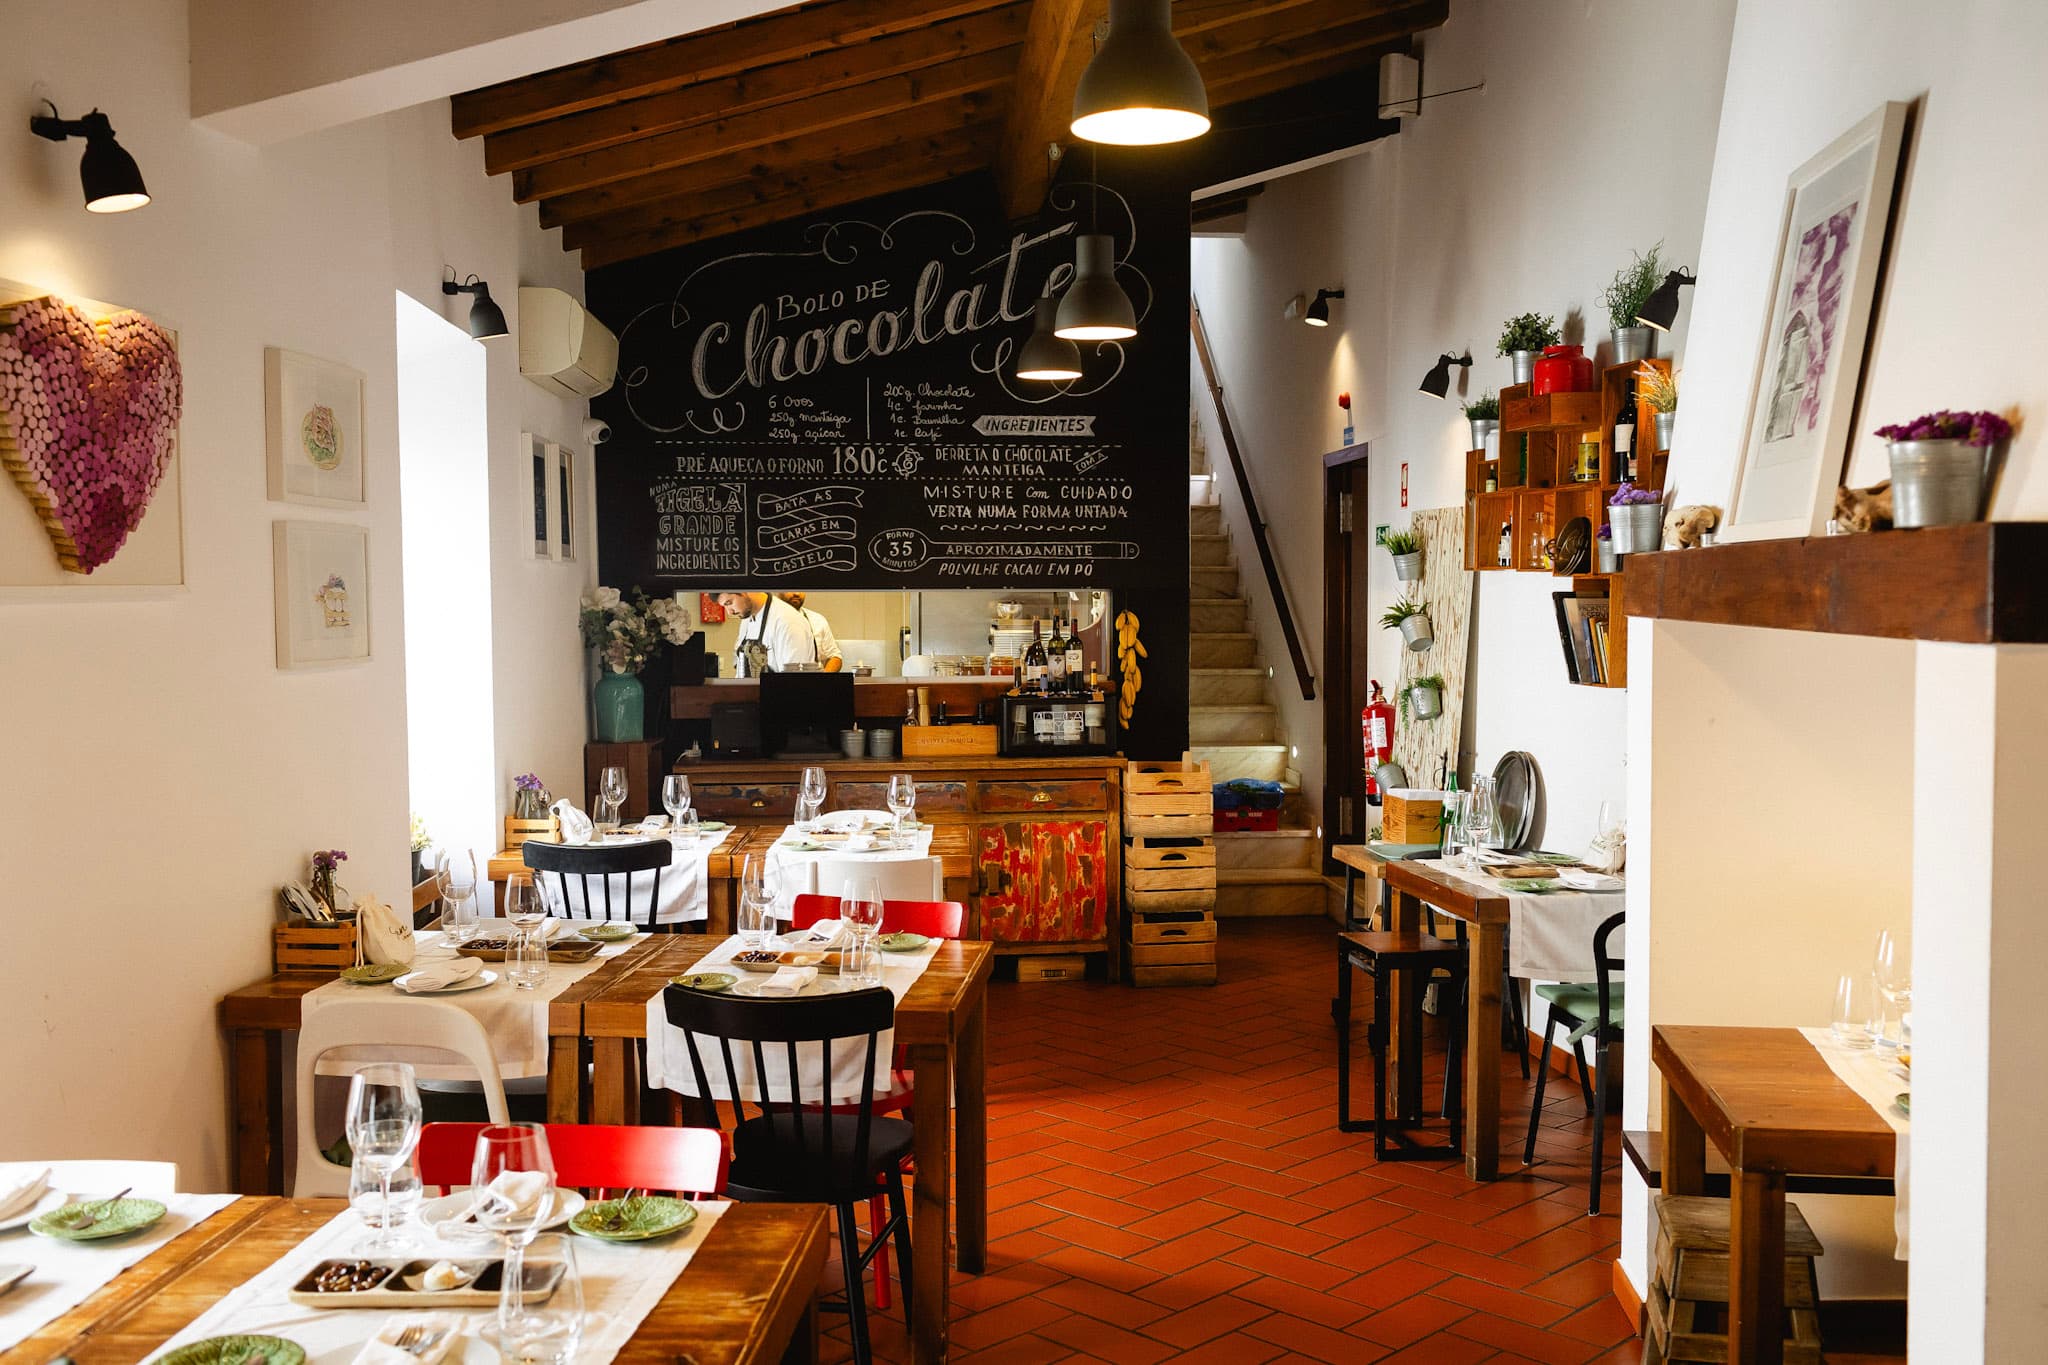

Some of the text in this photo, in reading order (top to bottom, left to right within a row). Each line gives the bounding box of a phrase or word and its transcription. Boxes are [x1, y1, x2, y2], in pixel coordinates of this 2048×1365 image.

[776, 279, 891, 321] BOLO DE
[918, 382, 976, 397] Chocolate
[768, 394, 814, 408] 6 Ovos
[912, 399, 964, 416] farinha
[799, 410, 852, 429] manteiga
[985, 418, 1087, 432] INGREDIENTES
[804, 427, 845, 442] açúcar
[935, 447, 1073, 463] DERRETA O CHOCOLATE
[767, 458, 776, 473] O
[779, 458, 825, 475] FORNO
[962, 464, 1046, 477] MANTEIGA
[649, 481, 678, 497] NUMA
[656, 486, 743, 514] TIGELA
[775, 489, 832, 513] BATA AS
[928, 504, 1128, 519] VERTA NUMA FORMA UNTADA
[659, 514, 737, 535] GRANDE
[773, 520, 840, 544] CLARAS EM
[656, 537, 740, 552] MISTURE OS
[889, 541, 913, 557] 35
[945, 545, 1093, 556] APROXIMADAMENTE
[656, 553, 741, 570] INGREDIENTES
[773, 549, 834, 573] CASTELO
[938, 559, 1095, 577] POLVILHE CACAU EM PÓ
